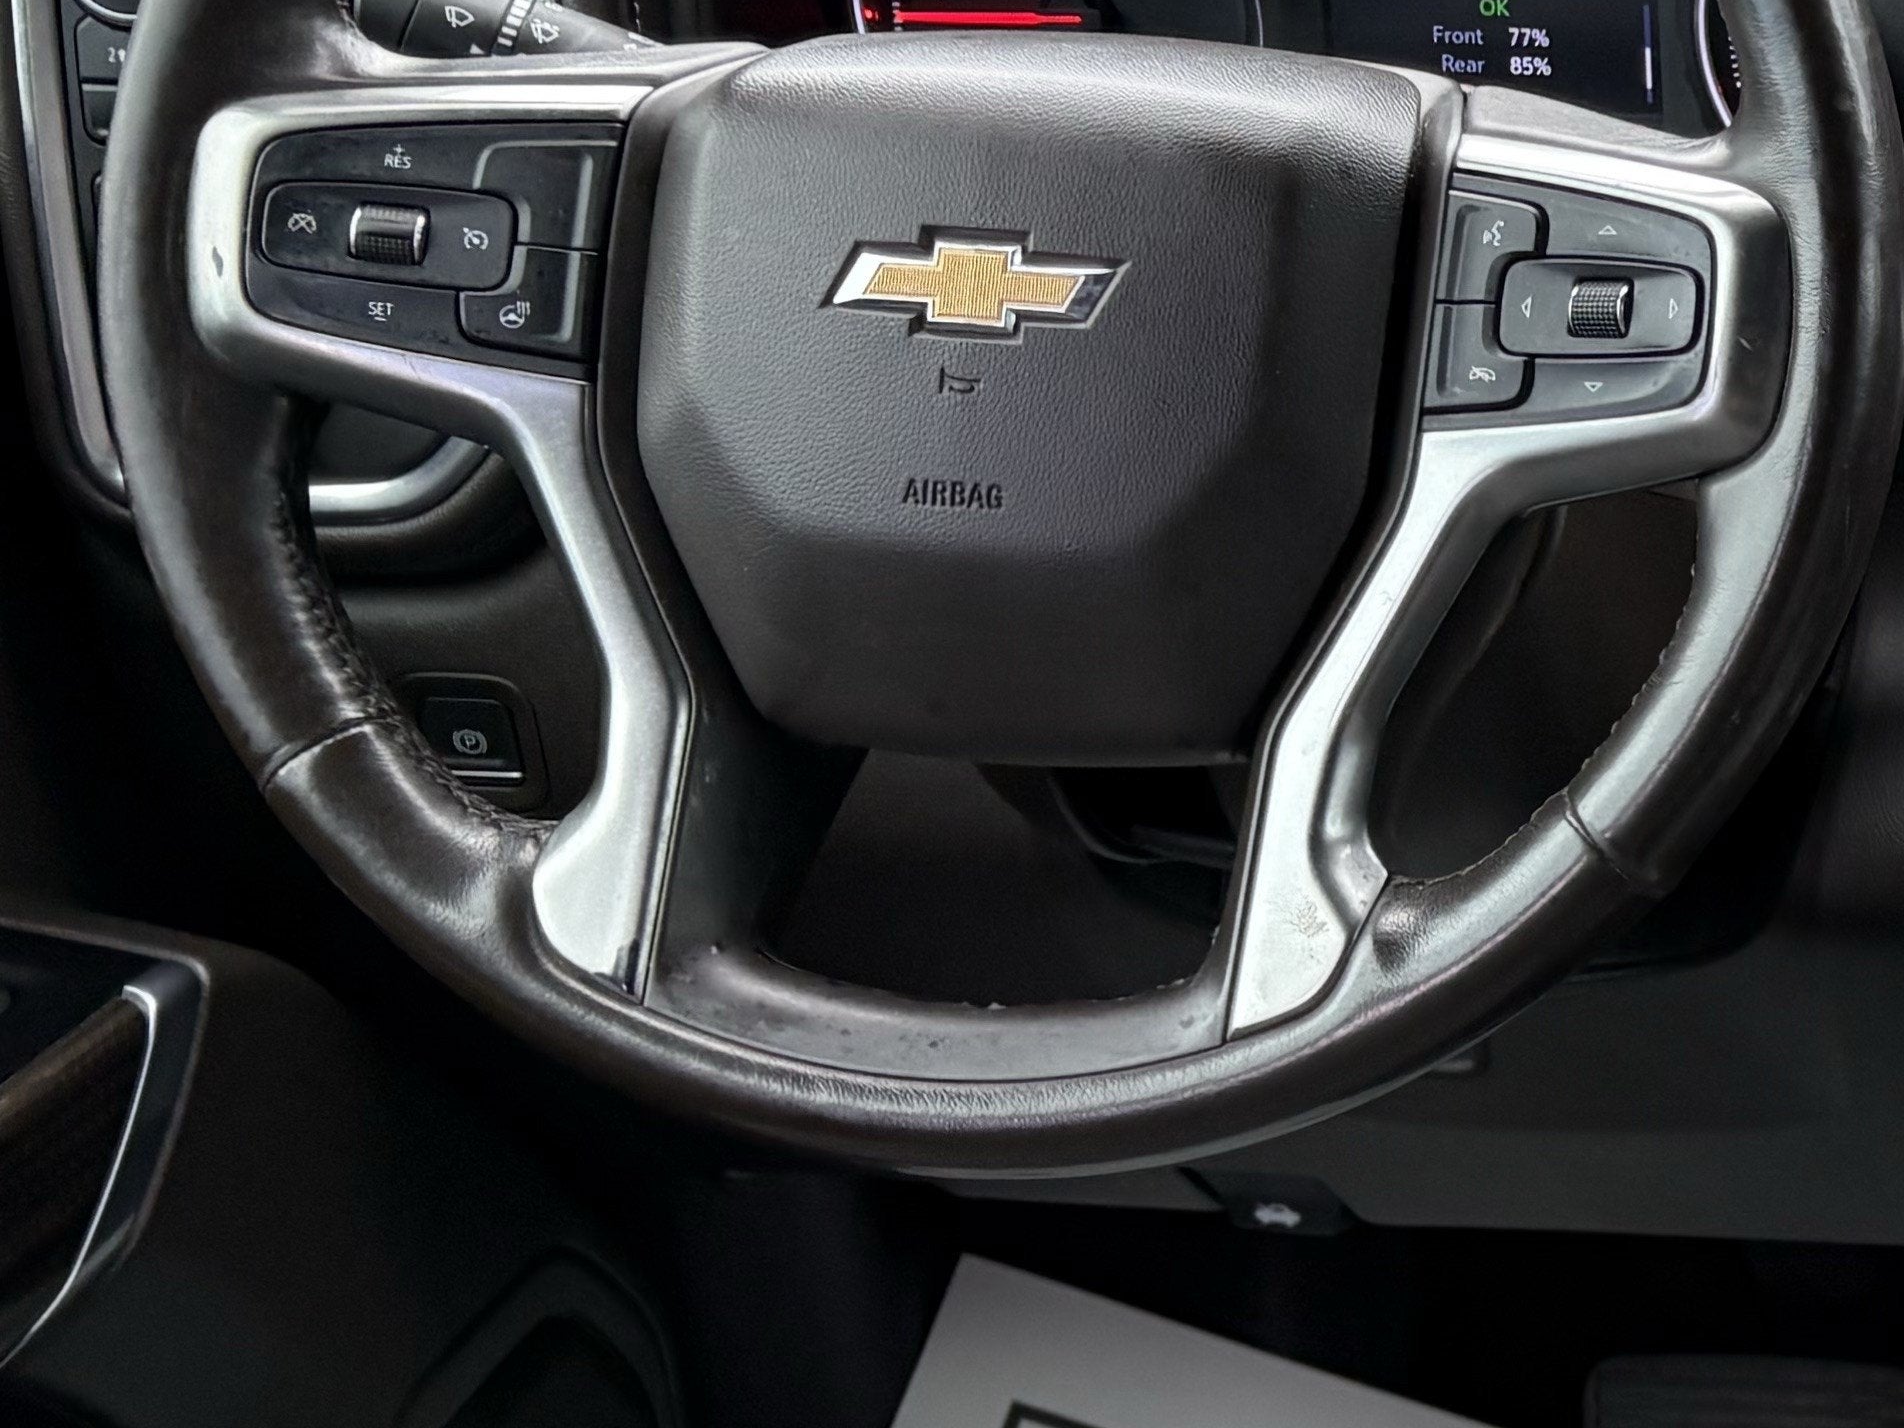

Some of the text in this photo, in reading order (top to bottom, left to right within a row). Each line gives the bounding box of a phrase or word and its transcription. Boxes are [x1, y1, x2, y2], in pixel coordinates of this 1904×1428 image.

[1432, 25, 1551, 48] Front 77%
[1441, 53, 1552, 77] Rear 85%
[383, 153, 412, 170] RES
[367, 300, 394, 316] SET
[901, 477, 1003, 510] AIRBAG
